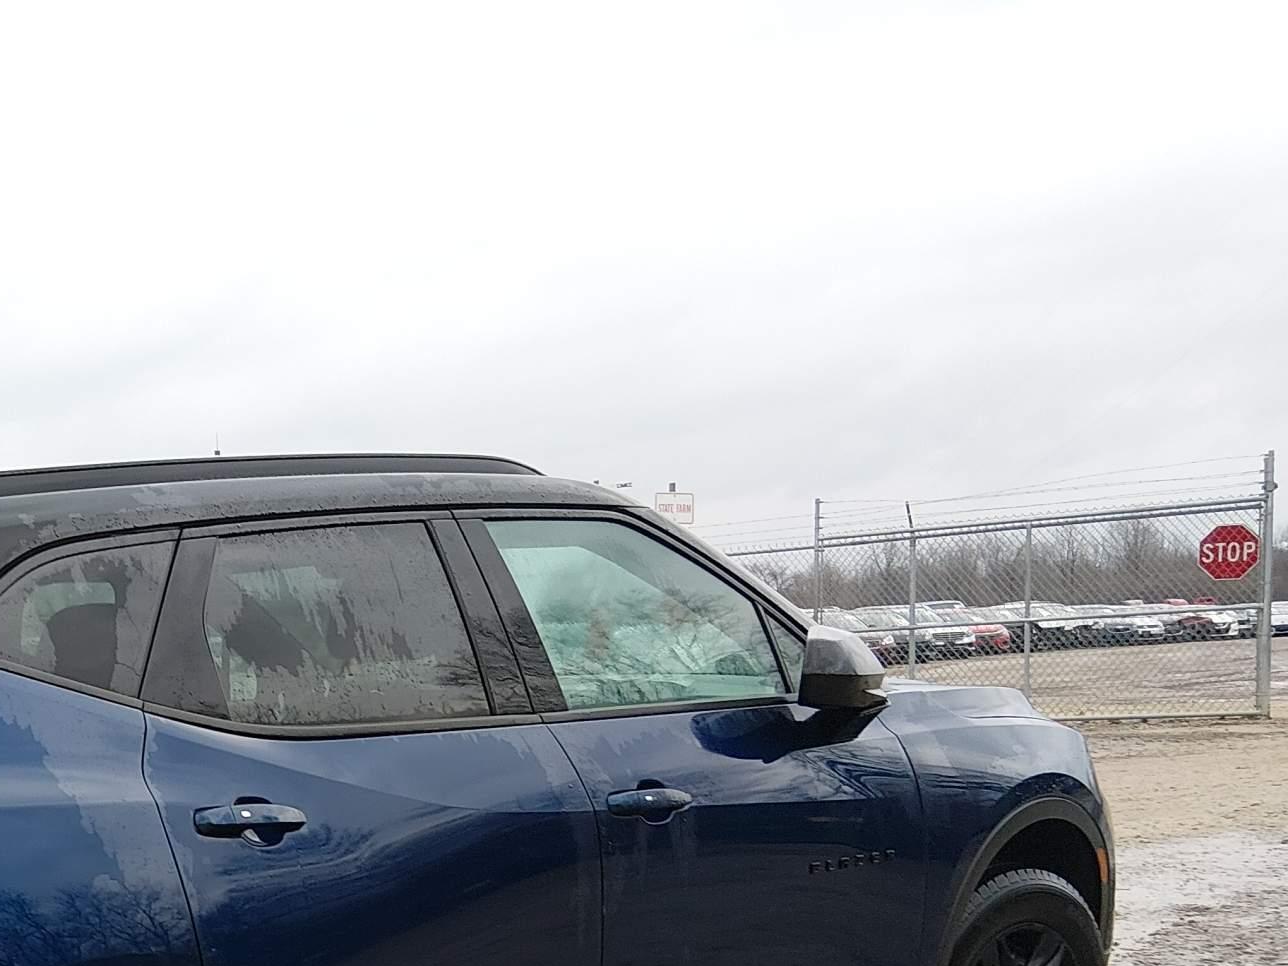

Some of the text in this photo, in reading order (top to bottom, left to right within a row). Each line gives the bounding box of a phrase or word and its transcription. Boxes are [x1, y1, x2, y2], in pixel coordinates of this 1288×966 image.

[658, 503, 691, 513] STATE FARM
[1201, 541, 1257, 564] STOP
